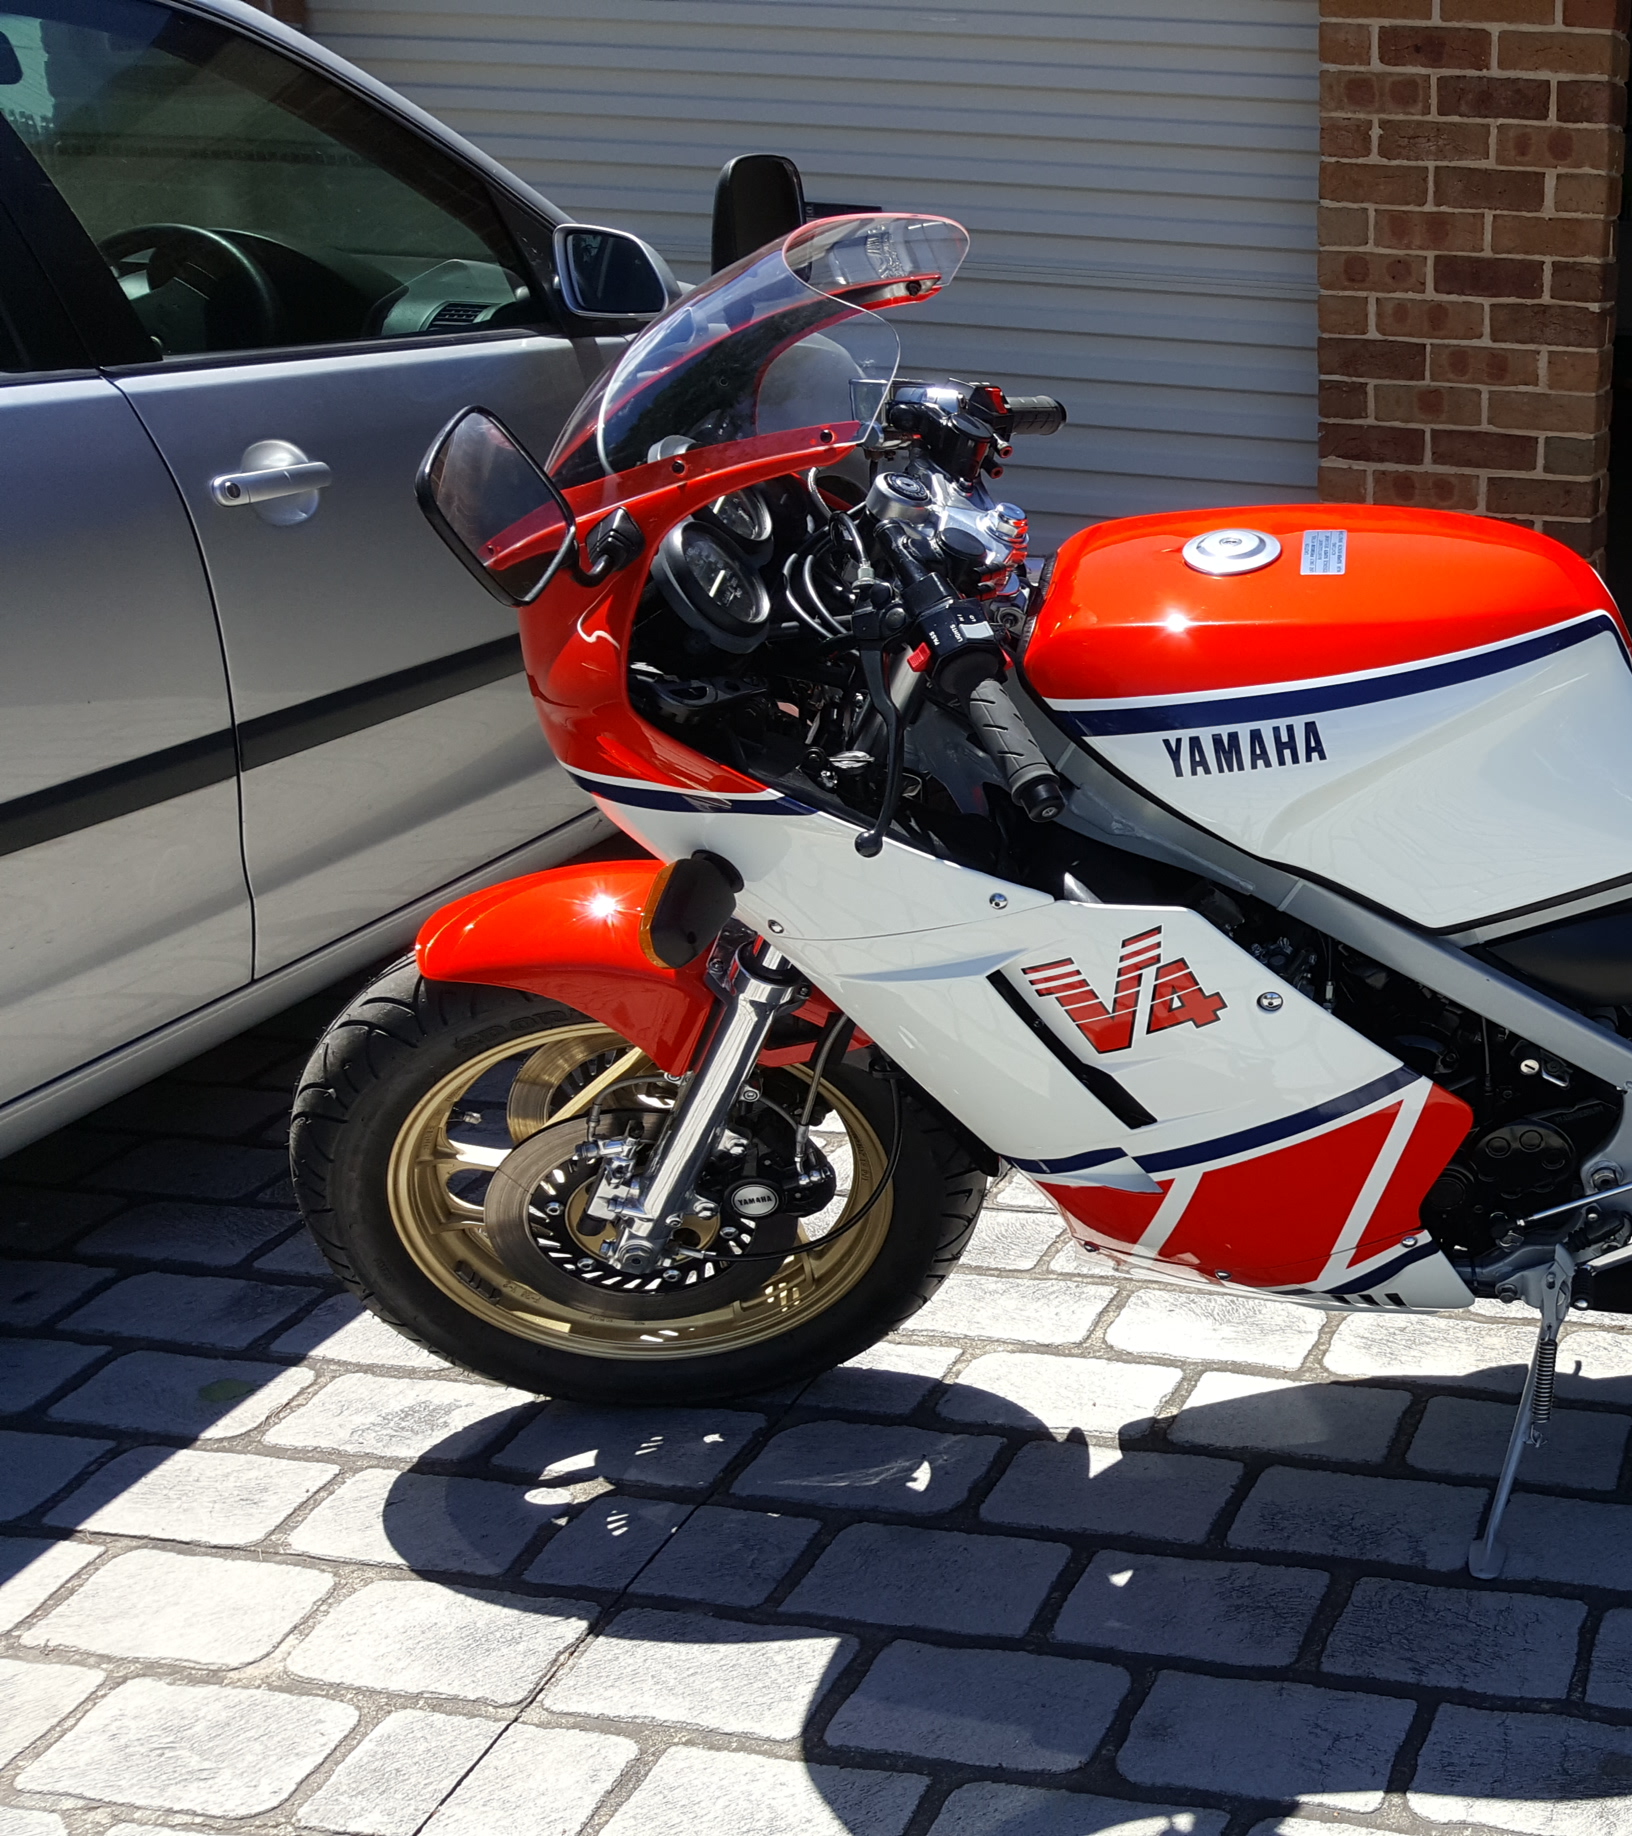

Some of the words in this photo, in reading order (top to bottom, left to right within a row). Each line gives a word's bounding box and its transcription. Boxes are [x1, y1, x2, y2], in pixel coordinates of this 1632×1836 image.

[929, 631, 940, 645] PASS
[950, 624, 963, 642] LIGHTS
[1163, 720, 1327, 778] YAMAHA
[1021, 925, 1228, 1054] V4
[737, 1195, 773, 1206] YAMAHA
